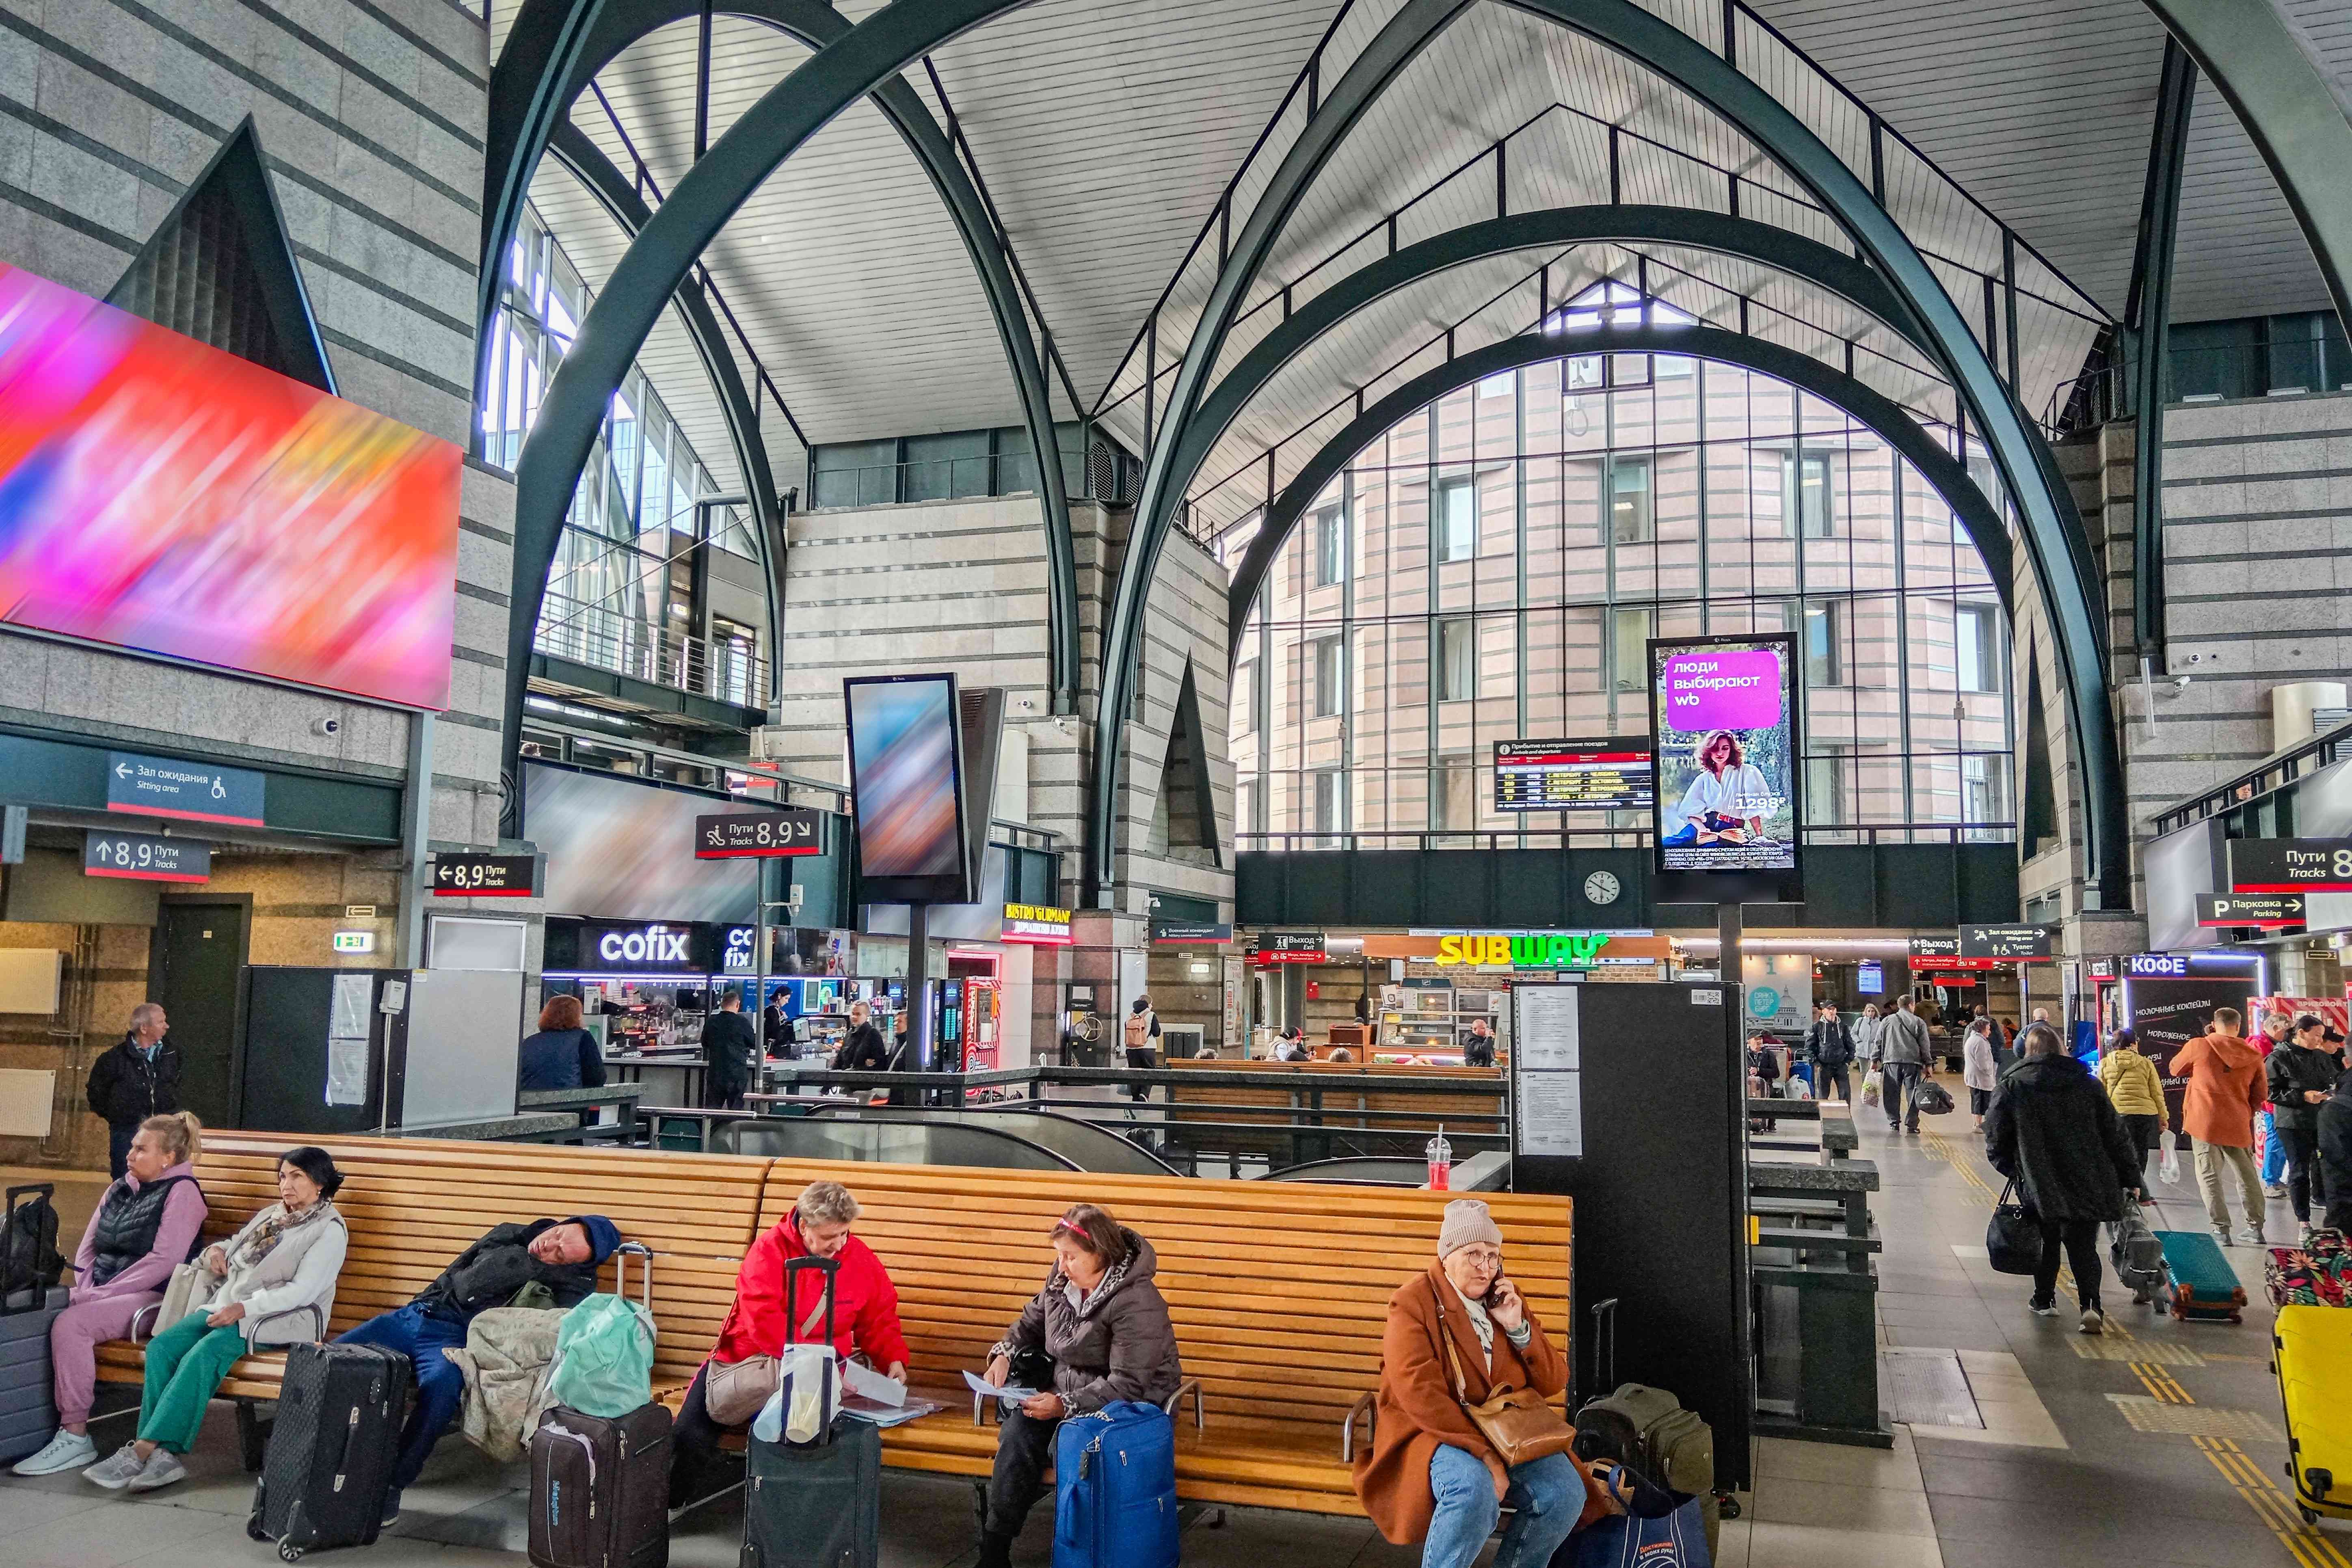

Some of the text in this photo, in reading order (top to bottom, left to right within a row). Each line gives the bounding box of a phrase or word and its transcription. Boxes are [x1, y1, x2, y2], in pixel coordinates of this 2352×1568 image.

[1673, 662, 1718, 674] люди
[1674, 675, 1761, 691] выбирают
[1674, 692, 1700, 706] wb
[136, 765, 208, 784] Зал ожидания
[136, 780, 161, 792] Sitting
[729, 824, 753, 836] Пути
[757, 821, 792, 848] 8,9
[730, 837, 753, 846] Tracks
[115, 842, 151, 870] 8,9
[154, 844, 179, 858] Пути
[154, 860, 177, 869] Tracks
[2286, 851, 2326, 866] Пути
[454, 865, 484, 889] 8,9
[485, 865, 506, 877] Пути
[2288, 868, 2326, 878] Tracks
[2214, 900, 2230, 918] P
[2233, 900, 2281, 909] Парковка
[1006, 904, 1034, 920] BISTRO
[2253, 910, 2282, 918] Parking
[600, 925, 689, 961] cofix
[1288, 936, 1315, 944] Выход
[1920, 939, 1953, 949] Выход
[1435, 932, 1610, 967] SUBWAY
[725, 947, 749, 967] fix
[2132, 957, 2186, 974] КОФЕ
[2136, 999, 2211, 1016] МОЛОЧНЫЕ КОКТЕЙЛИ
[2147, 1029, 2191, 1041] МОРОЖЕНОЕ
[2144, 1052, 2162, 1061] УЗИ
[2160, 1077, 2181, 1088] ДНЫЙ
[1645, 1549, 1660, 1558] моих
